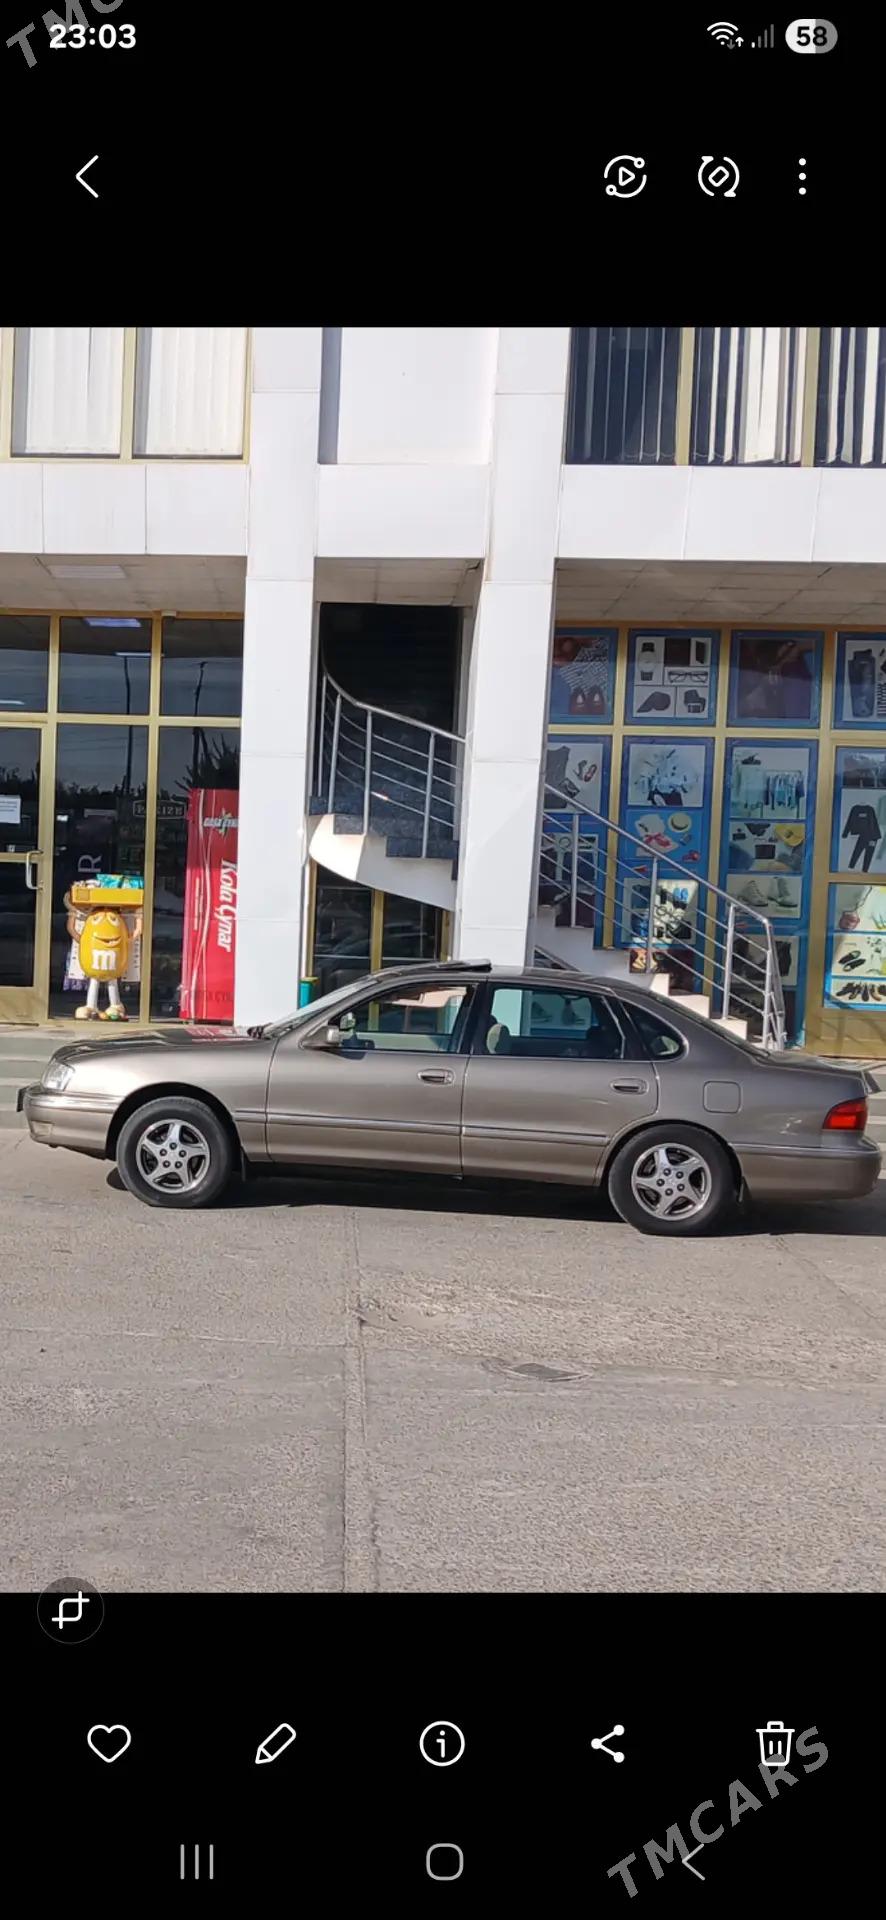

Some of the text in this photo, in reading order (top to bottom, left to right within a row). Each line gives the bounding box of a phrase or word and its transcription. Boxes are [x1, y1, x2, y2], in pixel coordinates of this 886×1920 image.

[49, 23, 137, 49] 23:03
[796, 26, 828, 47] 58
[91, 949, 117, 971] m
